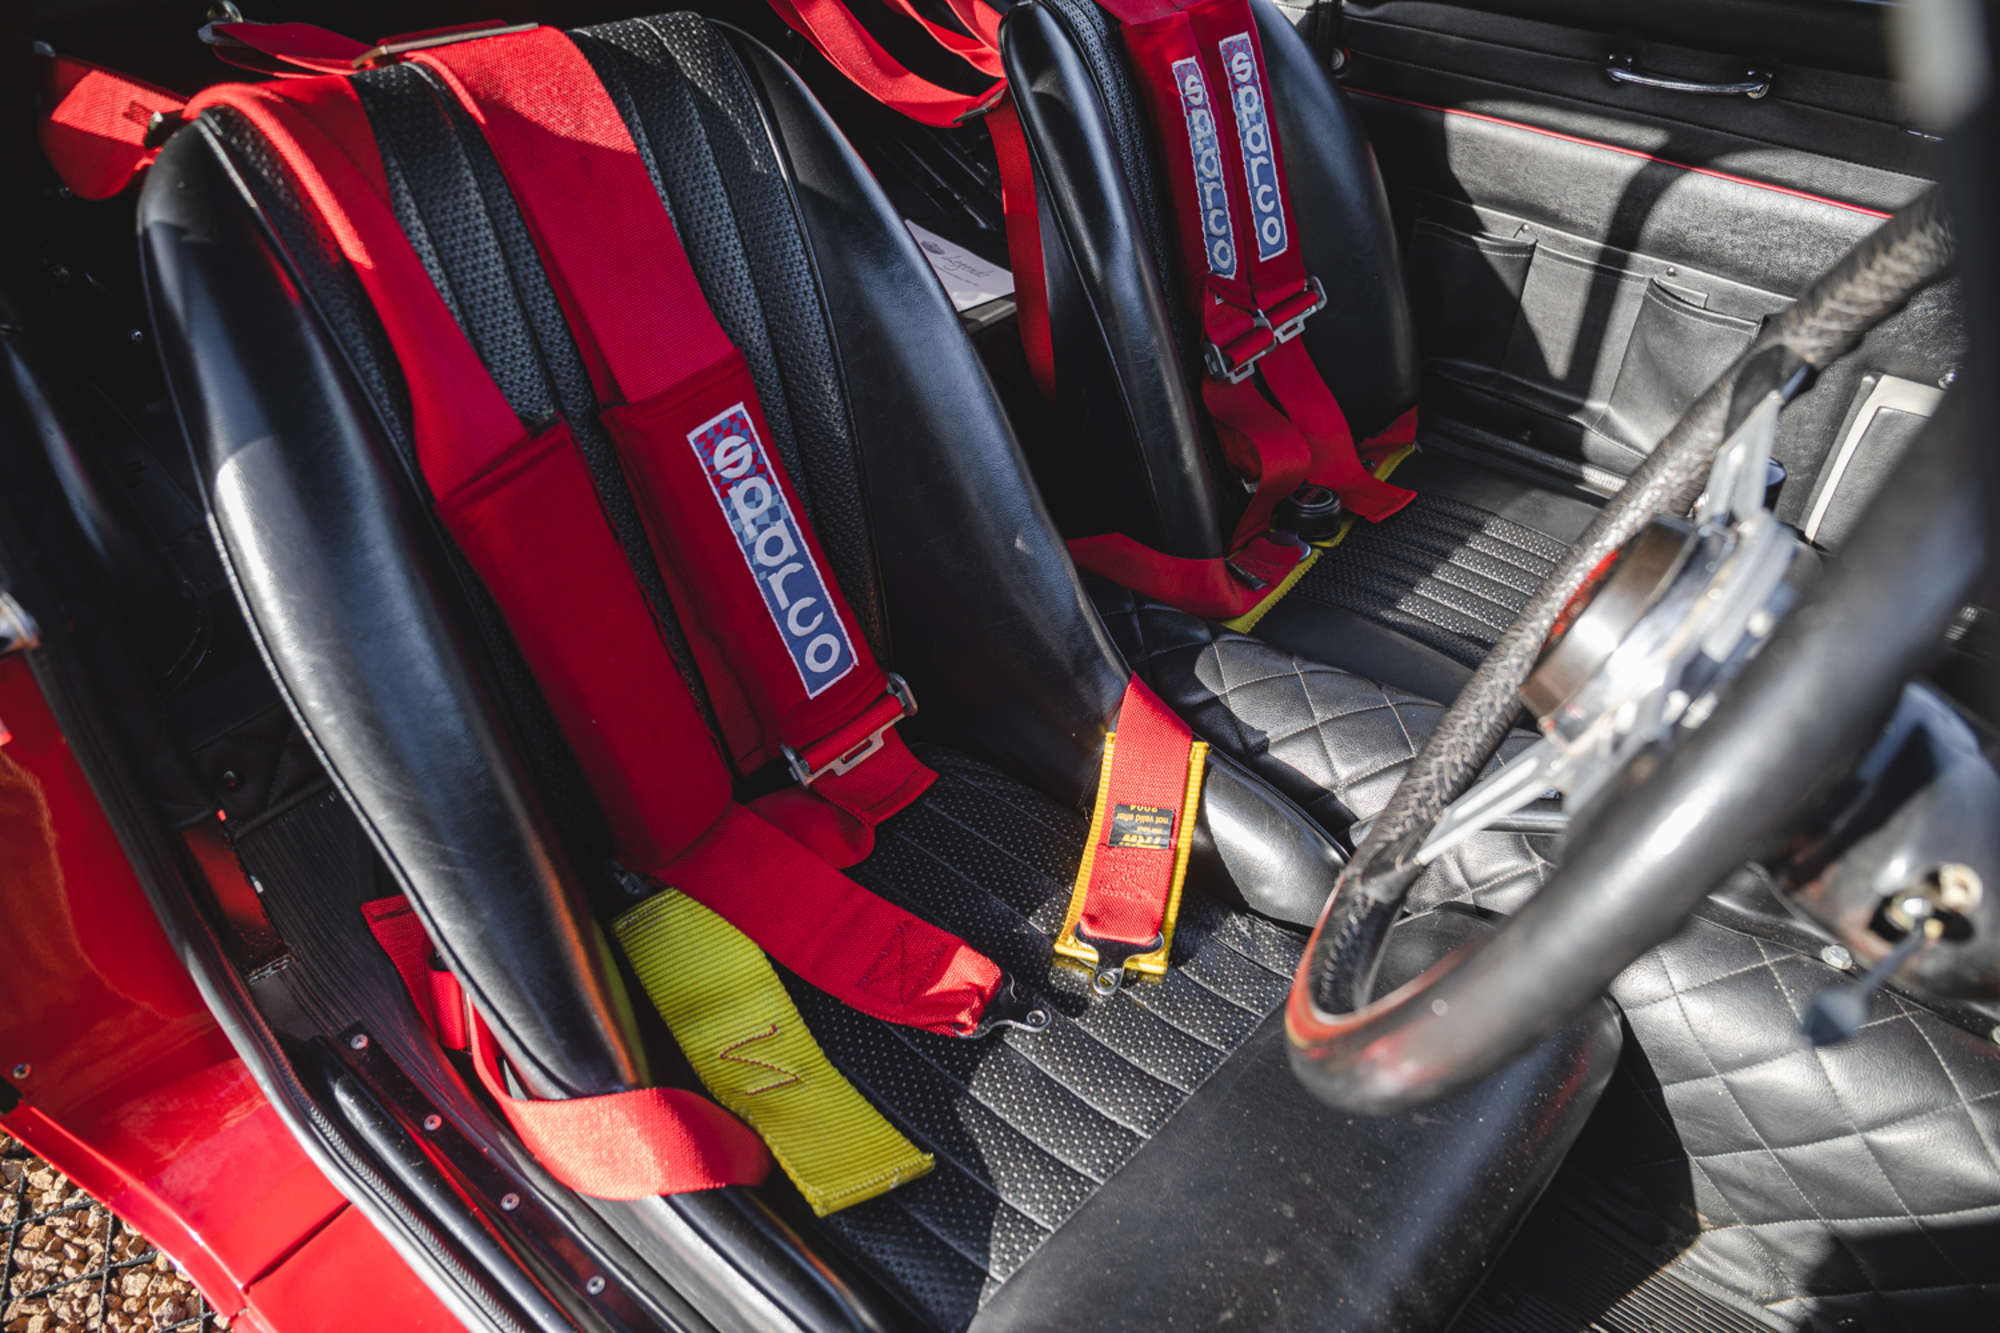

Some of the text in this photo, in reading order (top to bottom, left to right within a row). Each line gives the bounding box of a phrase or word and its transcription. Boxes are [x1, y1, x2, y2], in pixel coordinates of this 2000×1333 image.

[1184, 74, 1232, 269] sparco
[1232, 52, 1280, 245] sparco
[713, 435, 841, 673] sparco
[1135, 814, 1154, 824] valid
